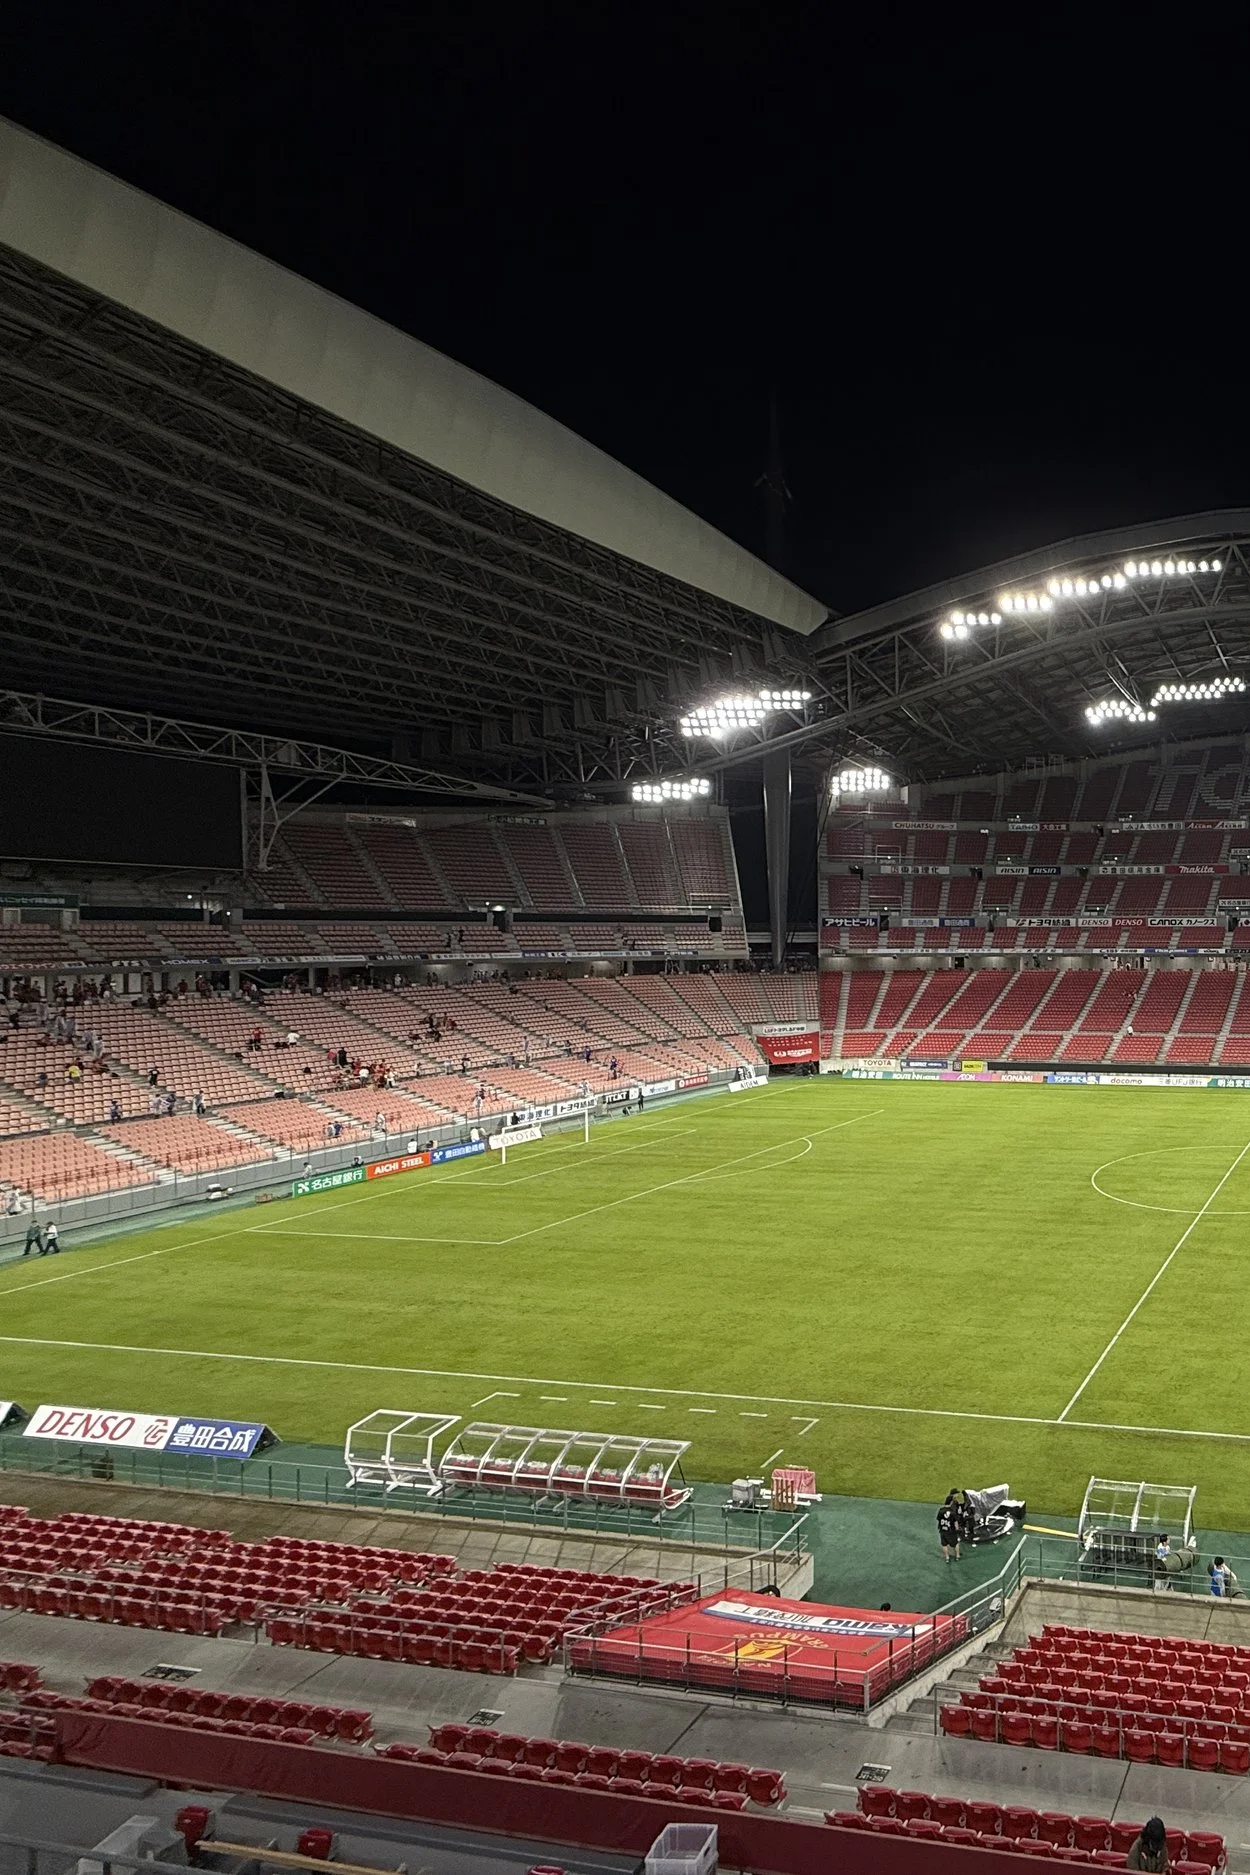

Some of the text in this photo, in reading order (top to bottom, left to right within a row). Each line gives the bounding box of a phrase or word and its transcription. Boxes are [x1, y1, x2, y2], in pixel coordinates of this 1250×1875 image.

[824, 918, 876, 928] アサヒビール
[863, 1059, 892, 1067] TOYOTA
[1001, 1074, 1033, 1082] KONAMI
[374, 1157, 425, 1175] AICHI STEEL
[311, 1169, 363, 1191] 名古屋銀行
[35, 1410, 137, 1442] DENSO
[169, 1422, 257, 1453] 豊田合成
